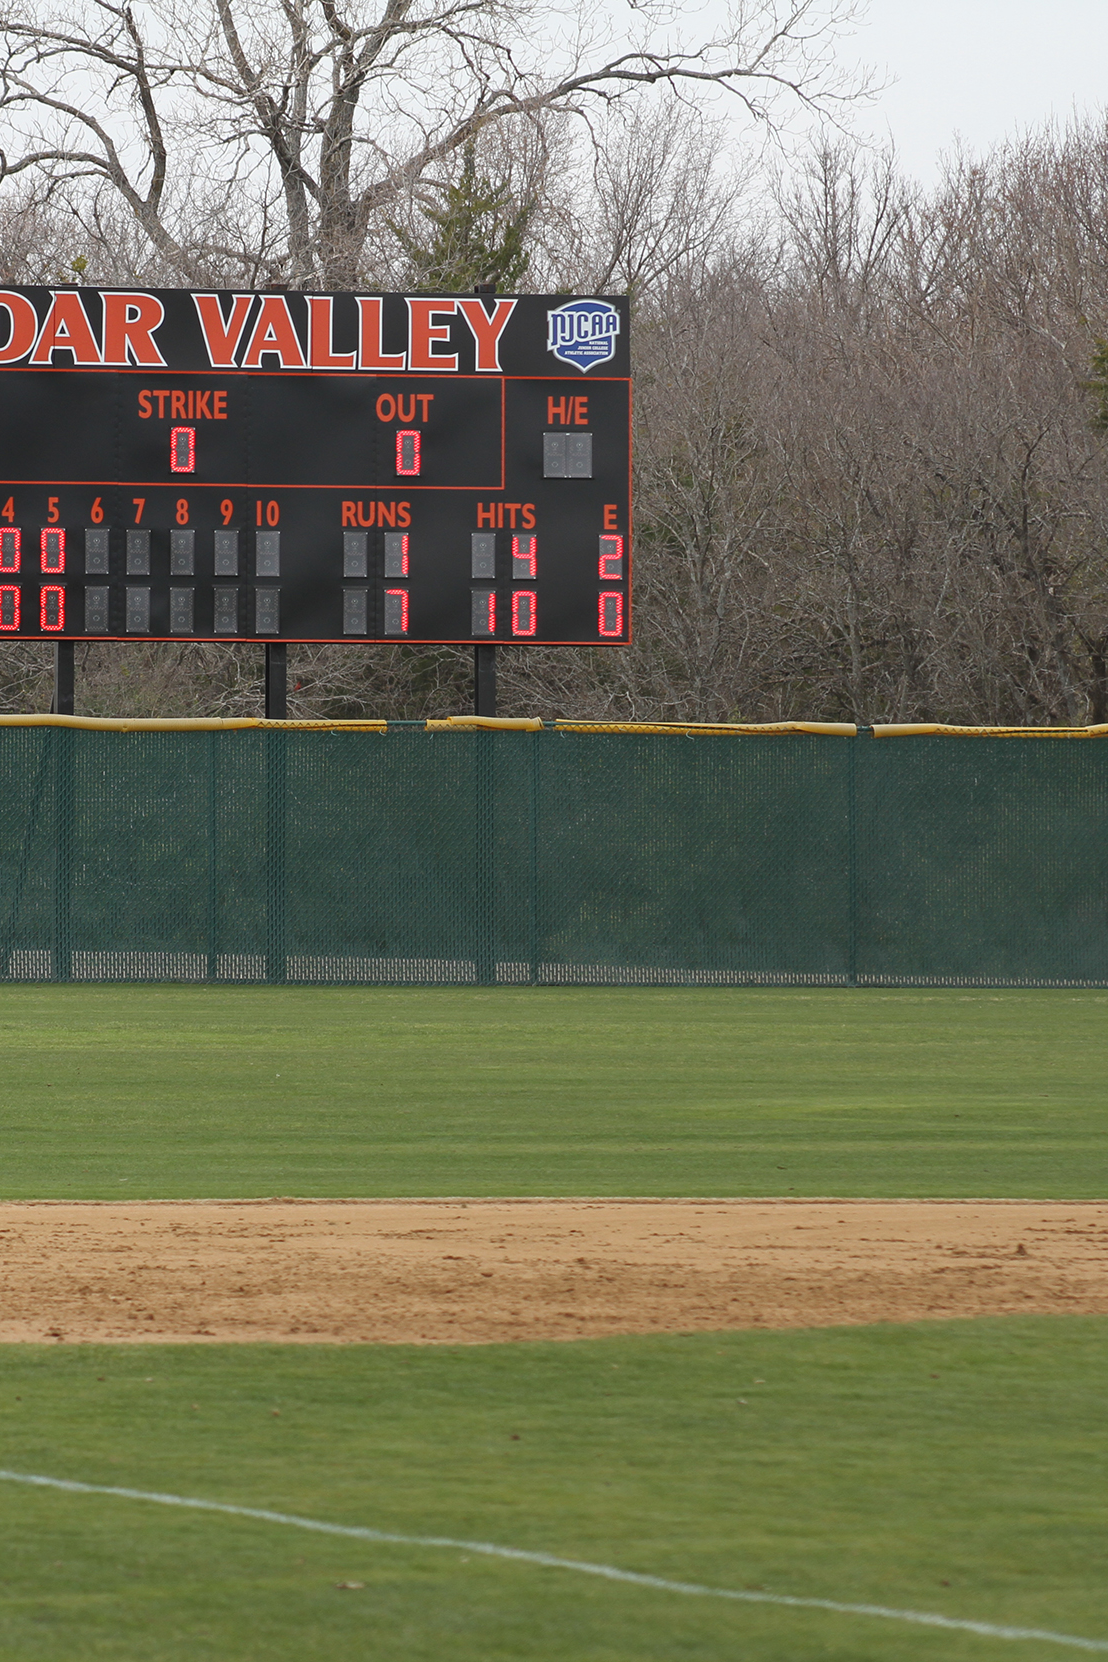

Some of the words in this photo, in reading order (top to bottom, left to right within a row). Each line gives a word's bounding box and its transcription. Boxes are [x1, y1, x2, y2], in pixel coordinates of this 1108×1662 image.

[191, 294, 517, 372] VALLEY
[549, 312, 618, 346] NJCAA
[138, 390, 227, 419] STRIKE
[376, 393, 434, 422] OUT
[548, 396, 588, 425] H/E
[170, 426, 196, 473] 0
[395, 430, 421, 476] 0
[2, 497, 15, 522] 4
[48, 497, 59, 523] 5
[91, 497, 104, 523] 6
[133, 498, 145, 523] 7
[176, 499, 189, 525] 8
[220, 499, 233, 525] 9
[257, 501, 279, 526] 10
[342, 501, 411, 527] RUNS
[477, 503, 536, 529] HITS
[604, 504, 617, 530] E
[40, 527, 66, 574] 0
[401, 535, 410, 574] 1
[511, 537, 538, 576] 4
[598, 534, 624, 580] 2
[39, 585, 66, 631] 0
[386, 589, 409, 632] 7
[488, 590, 538, 636] 10
[597, 591, 624, 637] 0
